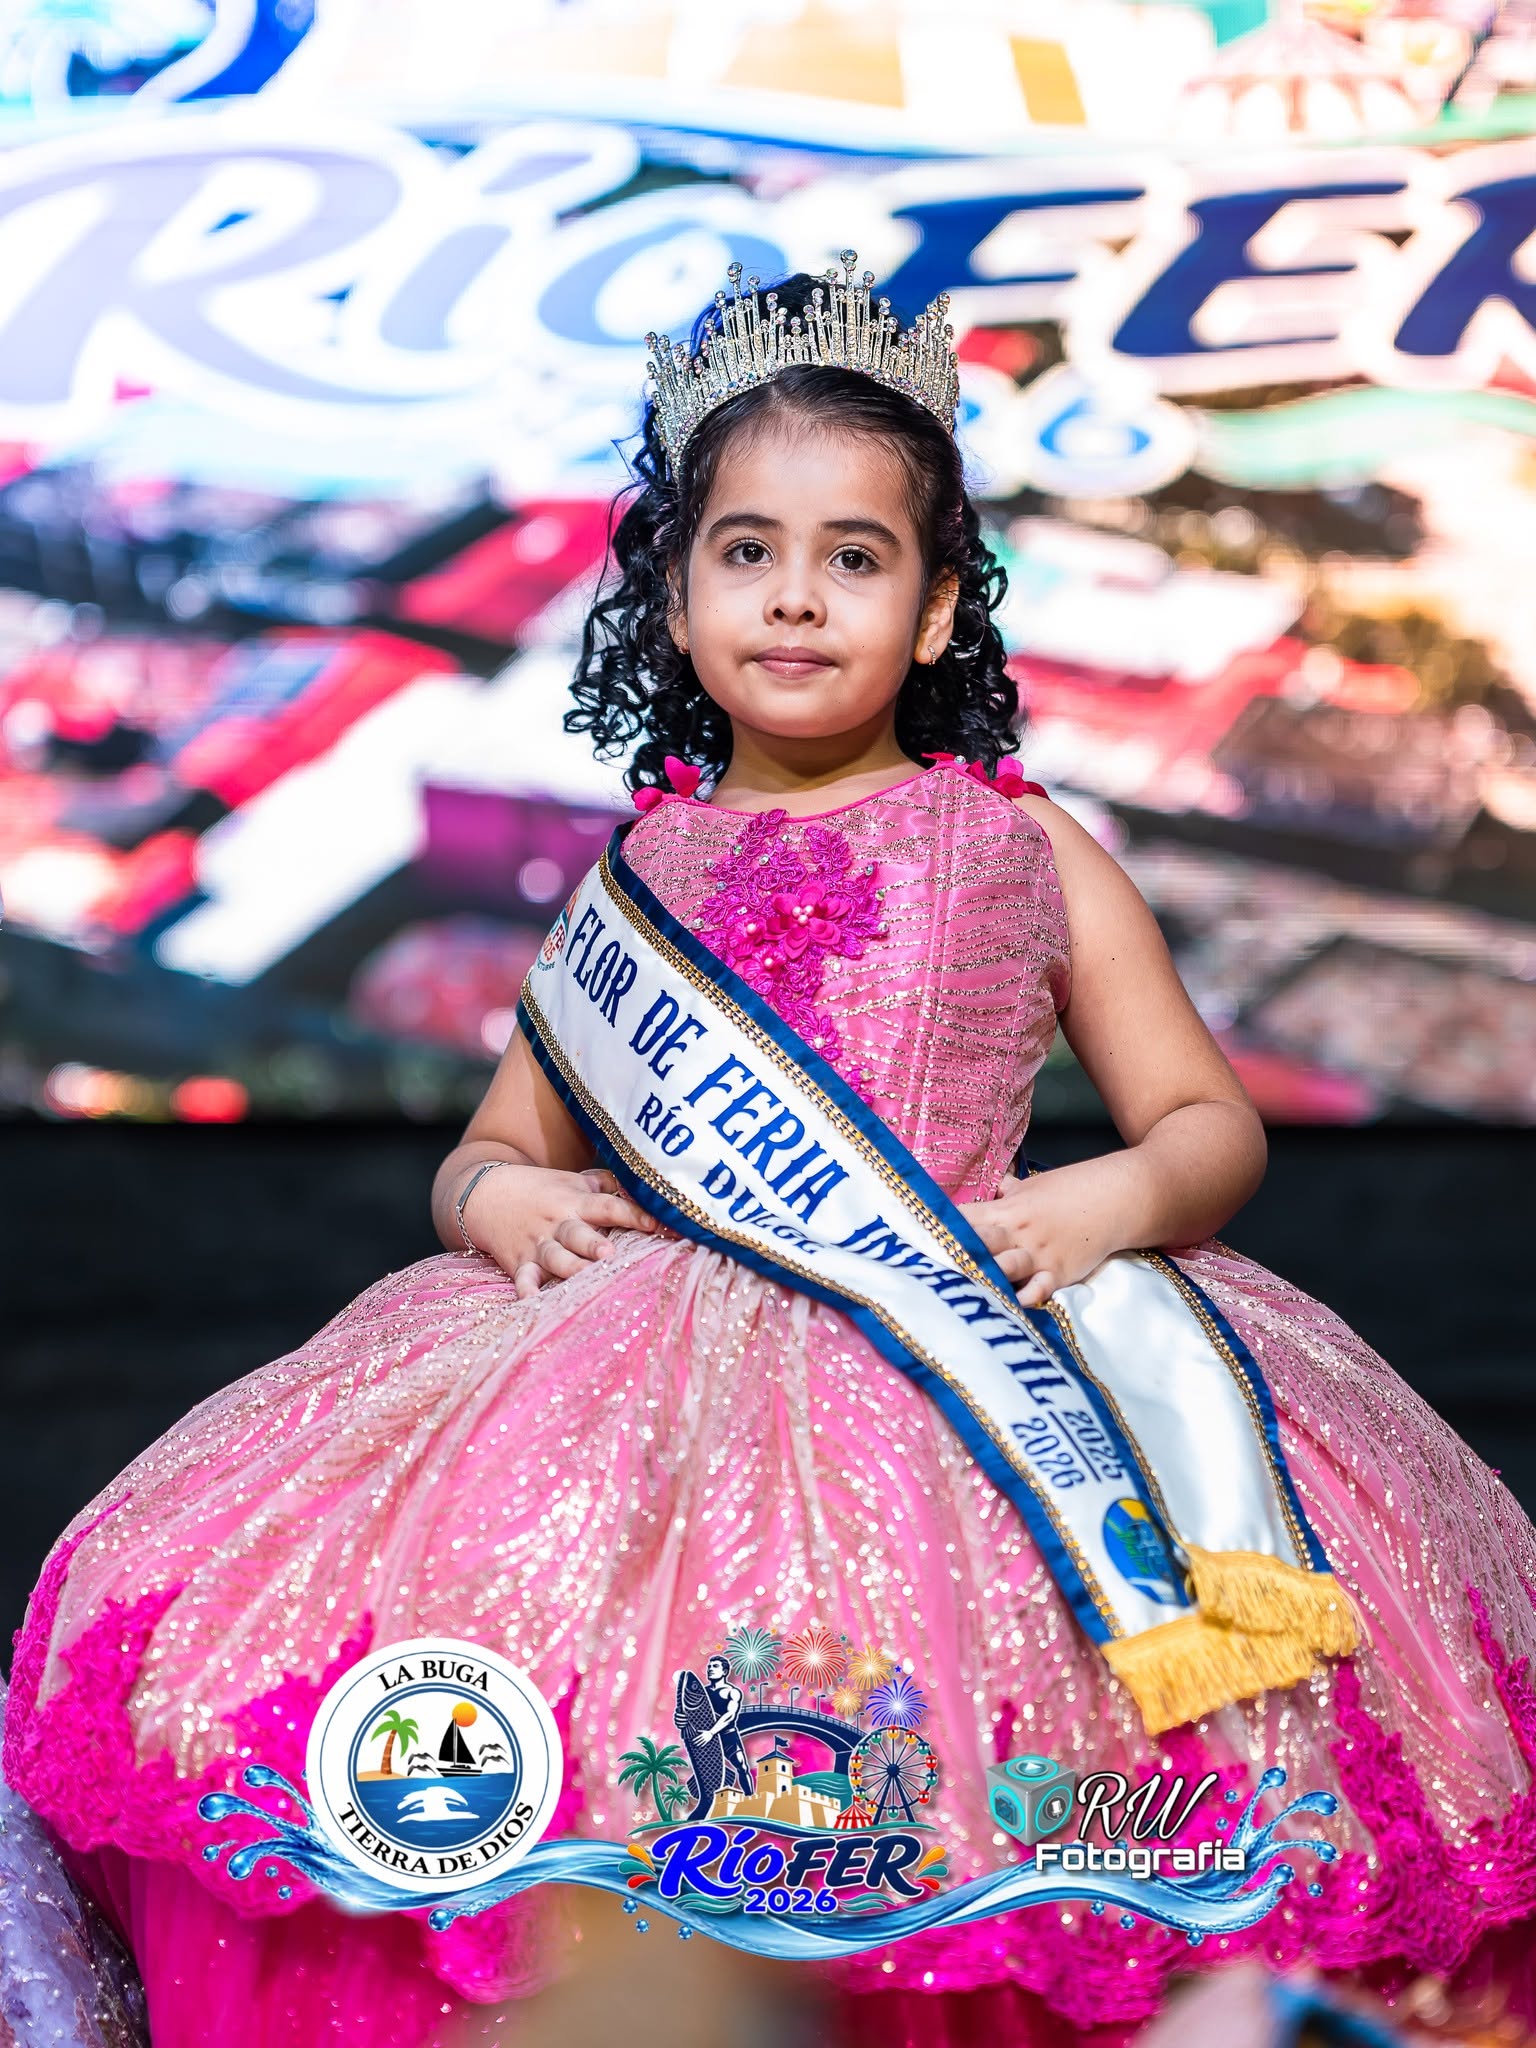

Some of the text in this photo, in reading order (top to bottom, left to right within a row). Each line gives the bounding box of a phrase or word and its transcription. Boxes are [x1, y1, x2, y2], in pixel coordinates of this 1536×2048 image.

[565, 903, 638, 1028] FLOR
[628, 989, 708, 1081] DE
[682, 1053, 850, 1225] FERIA
[634, 1093, 696, 1157] RÍO
[1010, 1416, 1086, 1489] 2026
[1063, 1409, 1128, 1482] 2025
